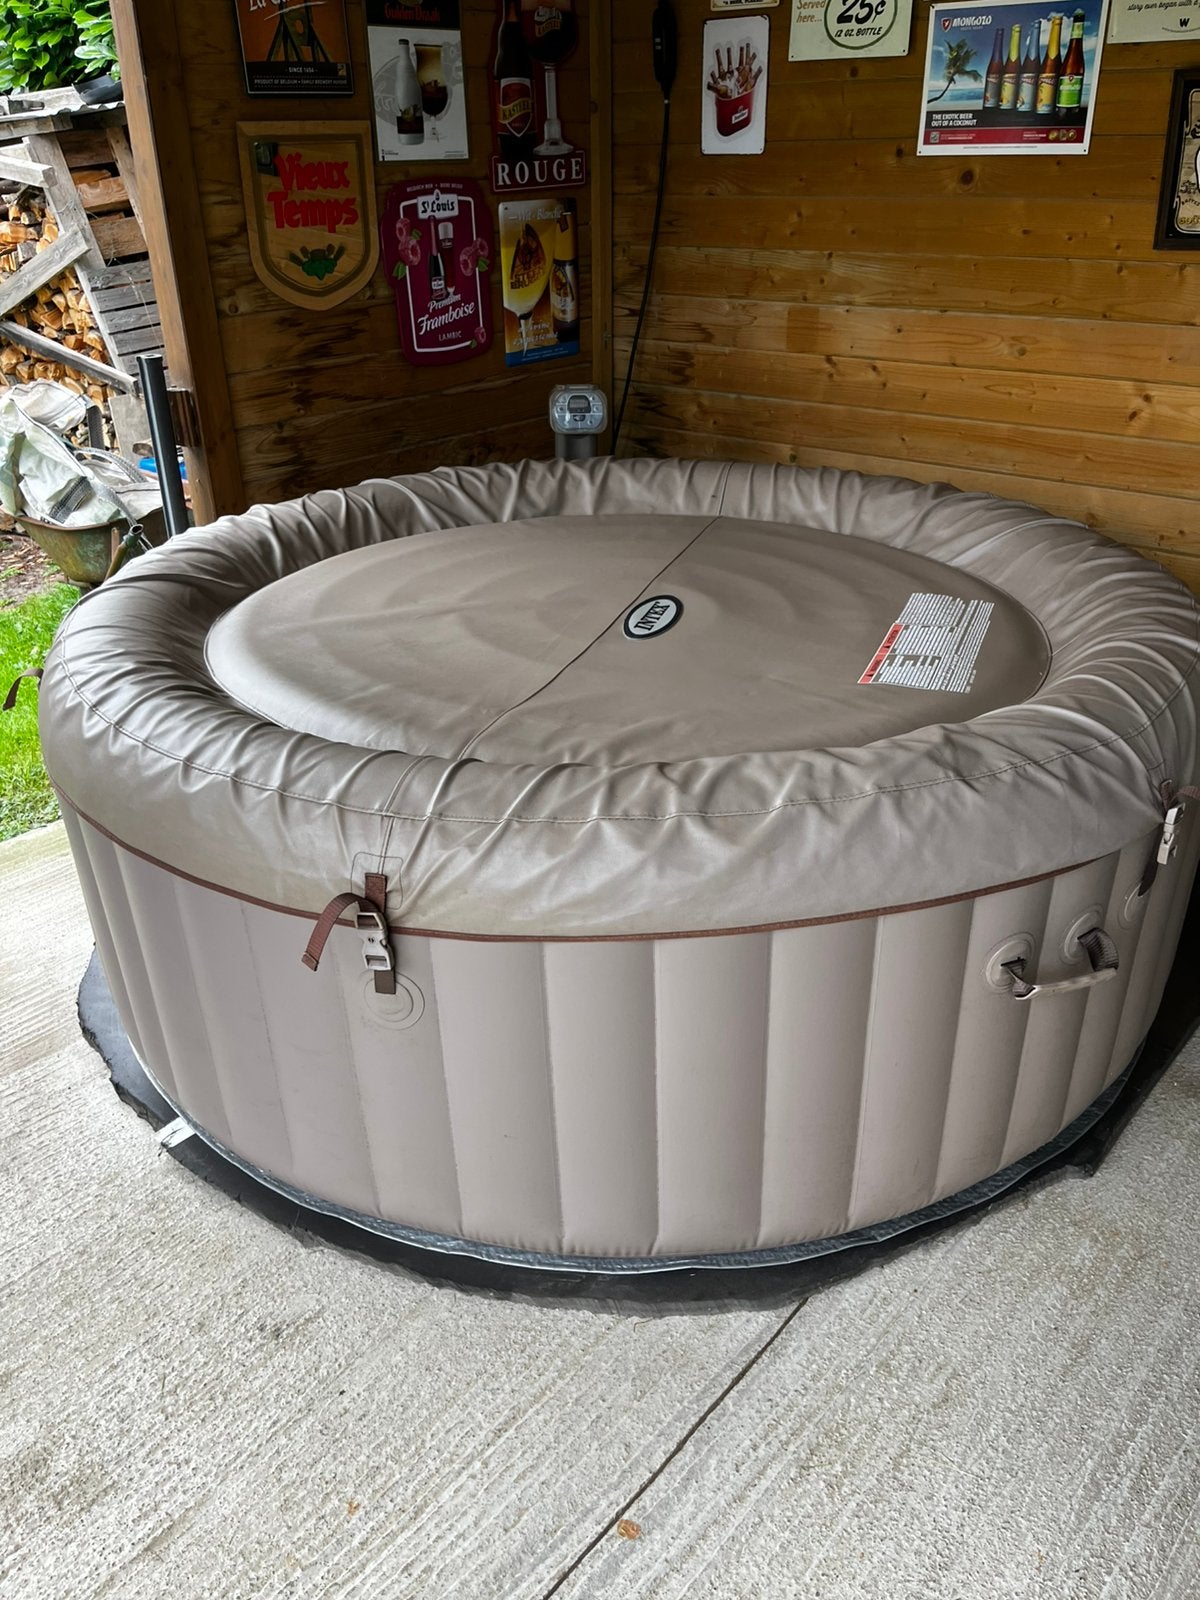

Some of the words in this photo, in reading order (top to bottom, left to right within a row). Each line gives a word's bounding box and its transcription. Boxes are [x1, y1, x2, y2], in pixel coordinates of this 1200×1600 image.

[797, 0, 826, 10] Served
[1158, 1, 1177, 10] began
[952, 15, 992, 27] MONGOZO
[1179, 18, 1190, 27] W
[834, 29, 842, 37] 12
[855, 26, 883, 37] BOTTLE
[274, 152, 350, 192] Vieux
[496, 157, 583, 187] ROUGE
[267, 190, 359, 233] Temps
[430, 199, 455, 213] Louis
[417, 302, 475, 335] Framboise
[438, 330, 462, 341] LAMBIC
[633, 601, 671, 631] INTEX
